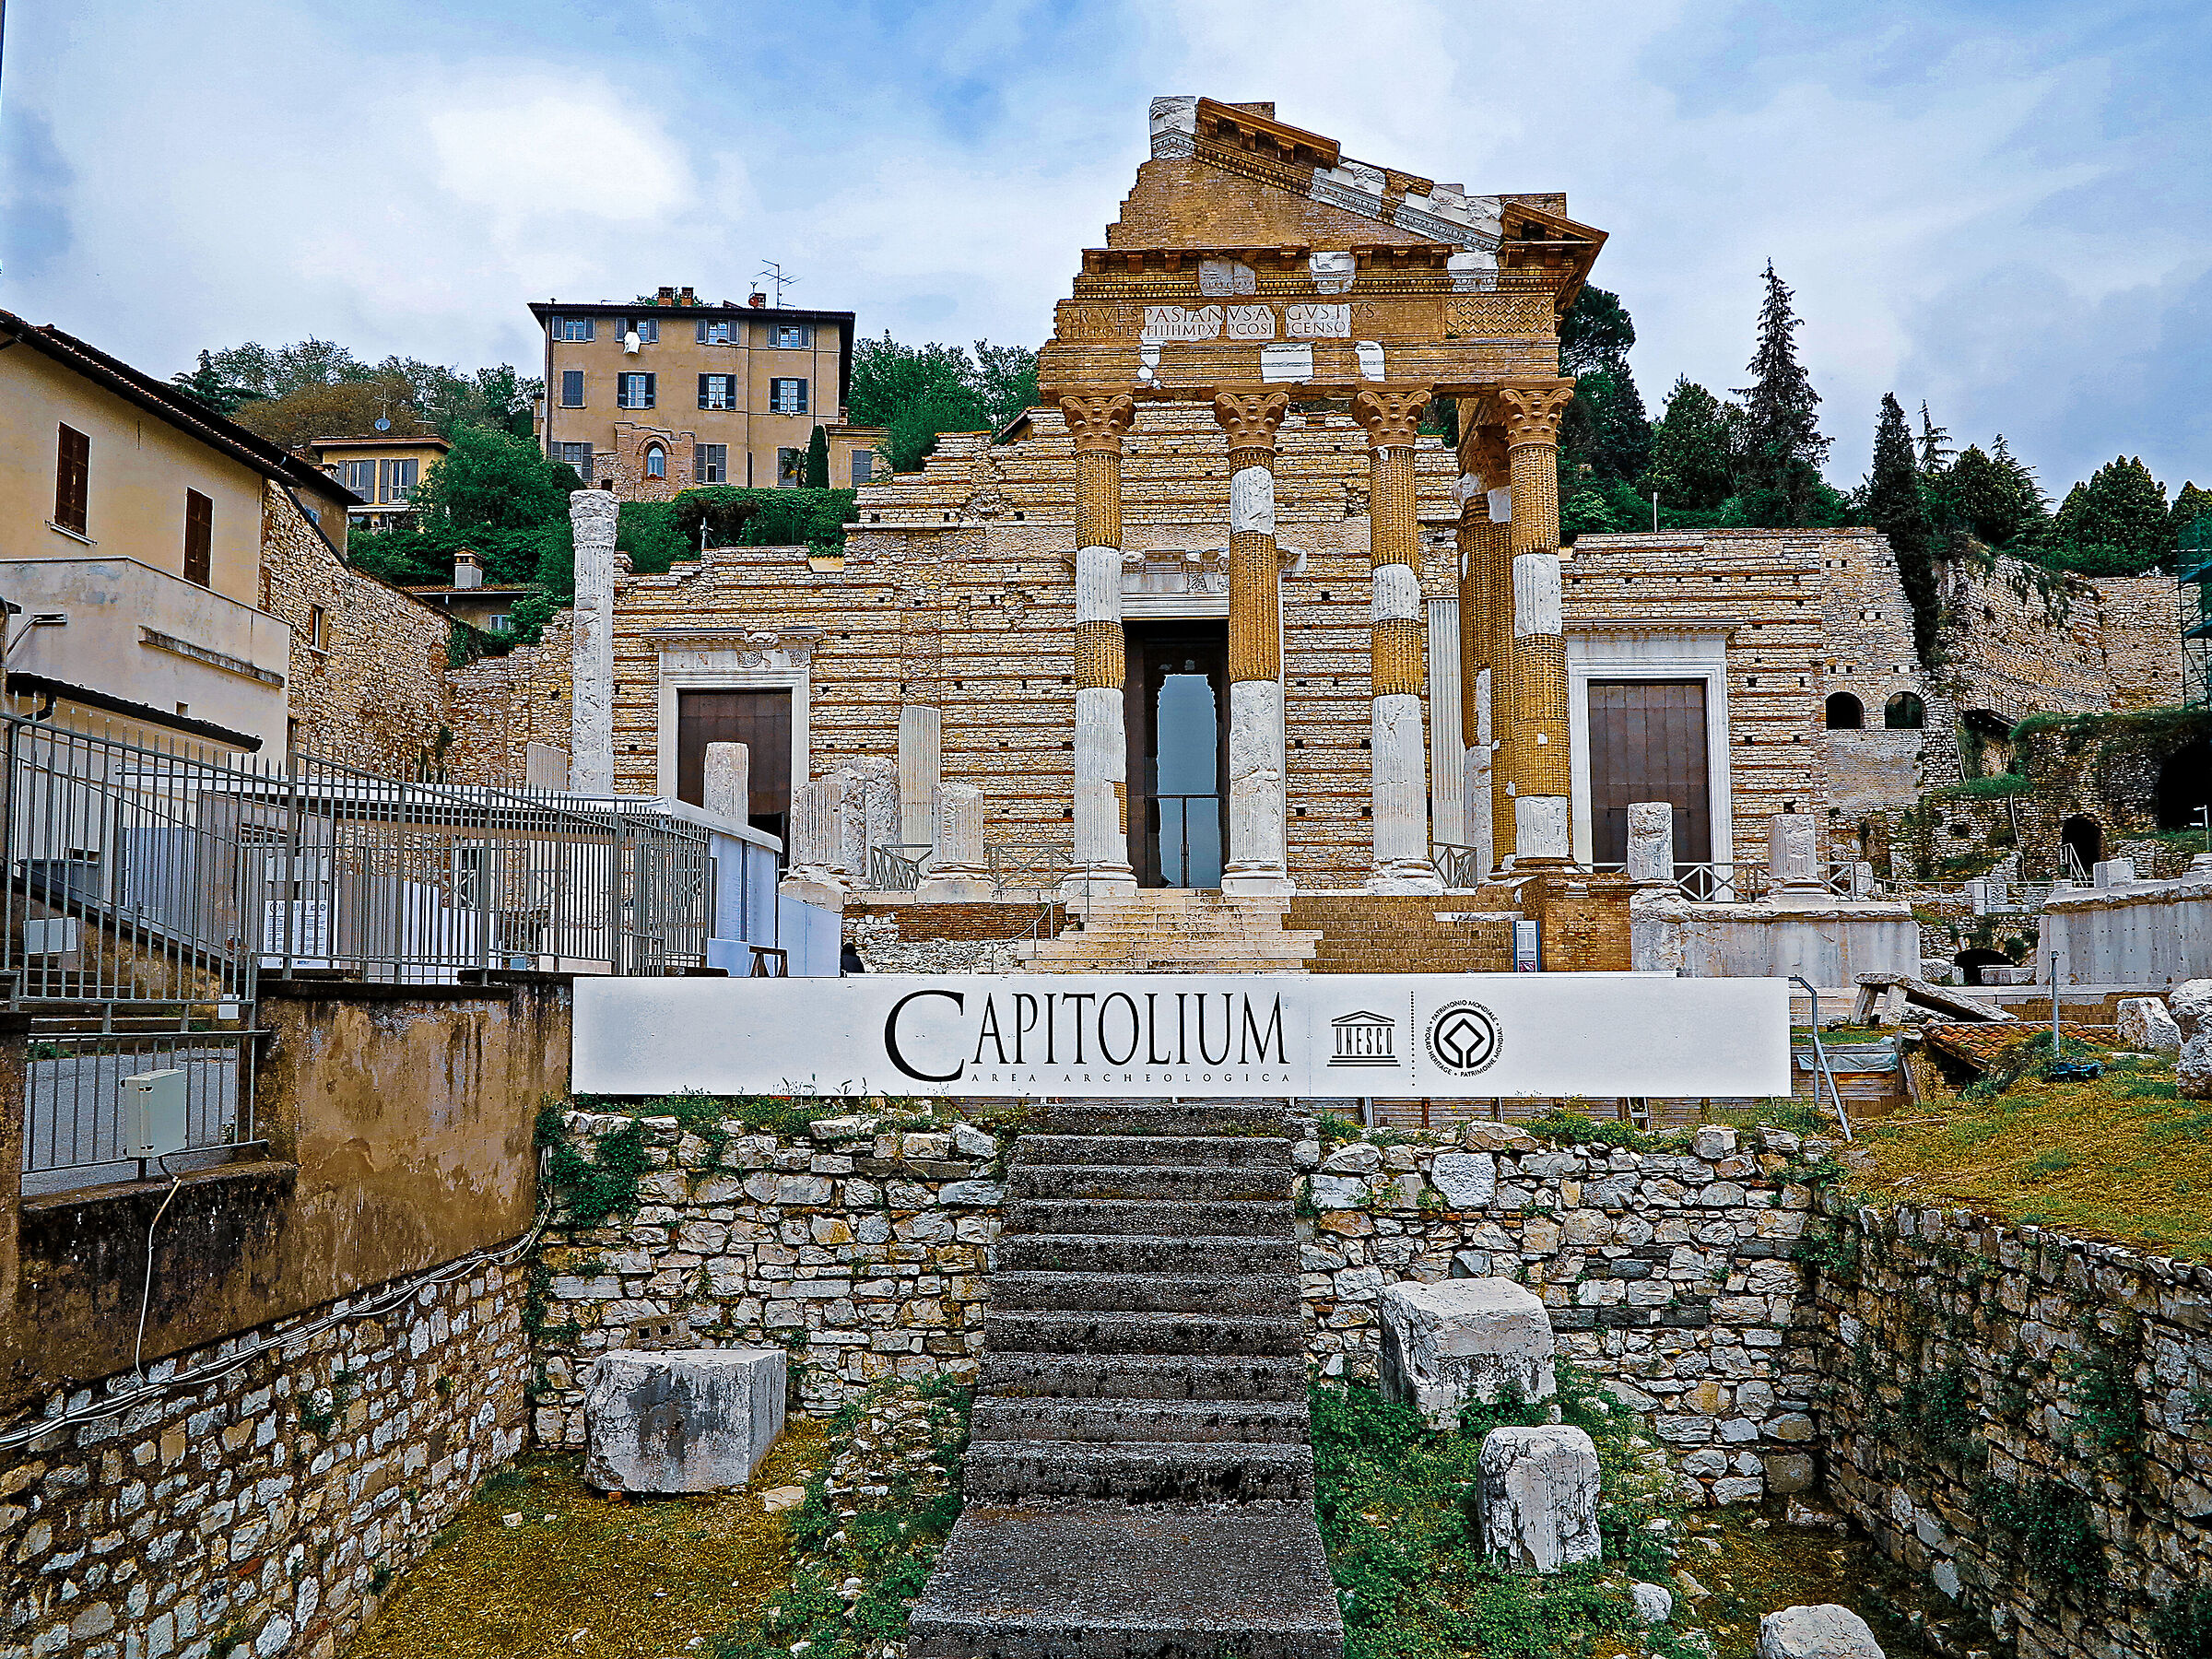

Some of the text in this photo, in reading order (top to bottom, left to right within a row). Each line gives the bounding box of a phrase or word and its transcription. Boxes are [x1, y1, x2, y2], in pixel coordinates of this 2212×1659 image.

[1431, 999, 1499, 1022] PATRIMONIO MONDIALE
[884, 990, 1290, 1082] CAPITOLIUM
[1335, 1027, 1393, 1054] UNESCO
[1429, 1051, 1453, 1076] HERITAGE
[1460, 1027, 1504, 1077] PATRIMOINE MONDIAL
[971, 1074, 1290, 1082] AREA ARCHEOLOGICA
